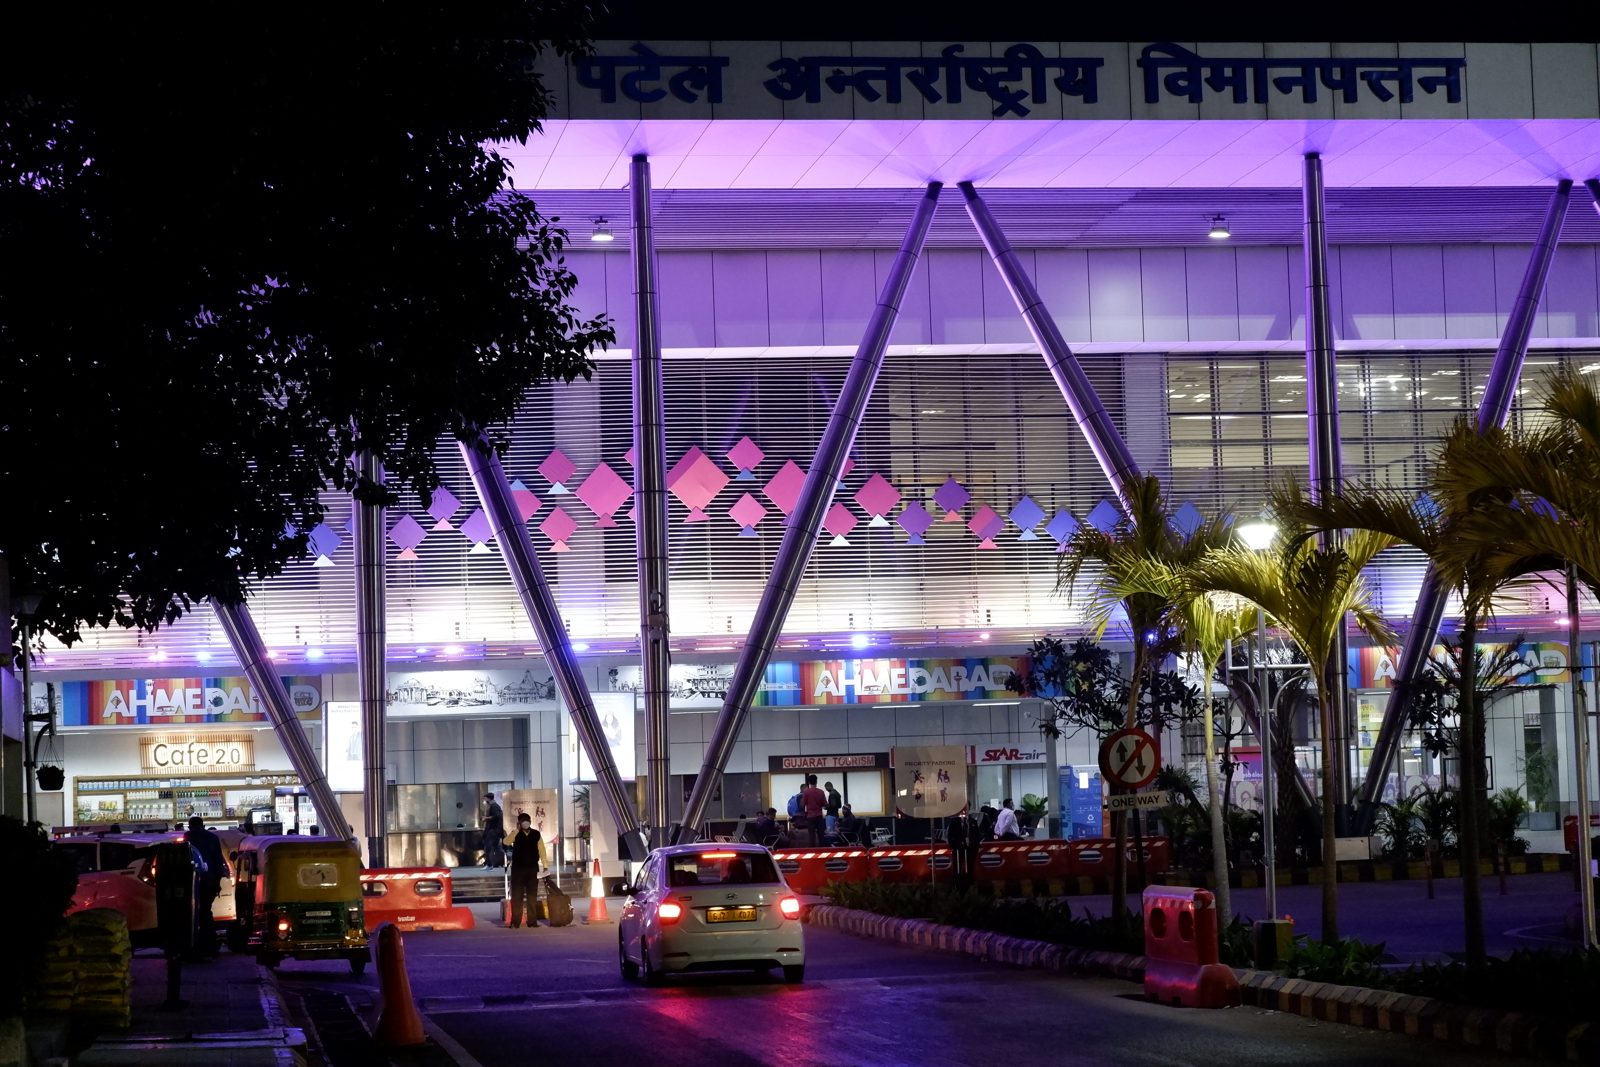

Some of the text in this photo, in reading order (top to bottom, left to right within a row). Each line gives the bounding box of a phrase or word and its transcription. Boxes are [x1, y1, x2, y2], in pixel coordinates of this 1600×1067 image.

[575, 41, 1467, 118] पटेल अन्तर्राष्ट्रीय विमानपत्तन
[814, 664, 1017, 697] AHMEDABAD
[103, 685, 321, 719] AHMEDAD
[153, 742, 241, 767] Cafe 2.0
[784, 756, 875, 768] GUJARAT TOURISM
[981, 747, 1047, 762] STAR air
[1112, 795, 1160, 808] ONE WAY
